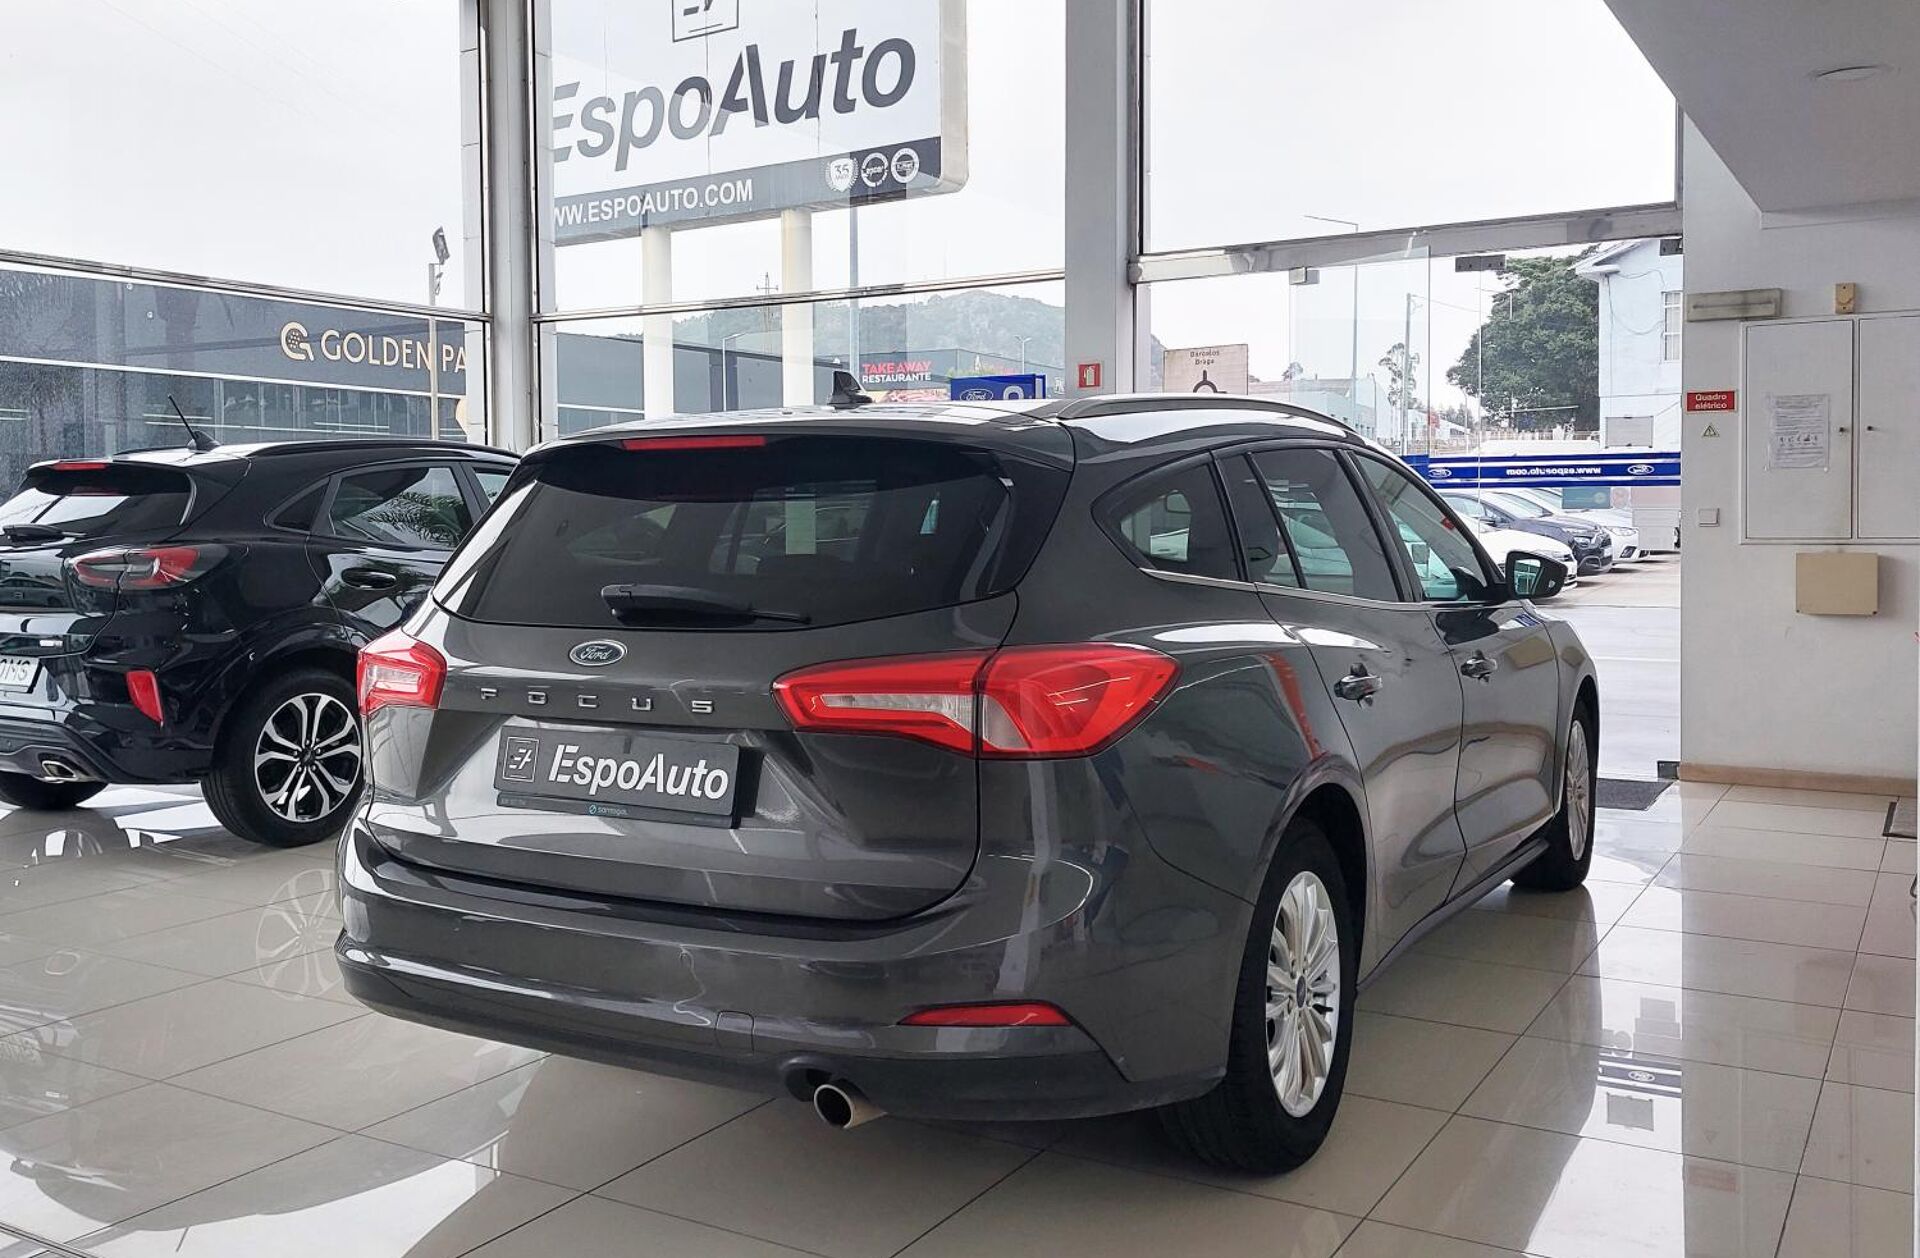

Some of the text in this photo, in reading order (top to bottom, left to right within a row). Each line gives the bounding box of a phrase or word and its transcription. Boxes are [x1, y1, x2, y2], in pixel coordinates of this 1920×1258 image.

[553, 28, 916, 172] EspoAuto
[320, 329, 431, 371] GOLDEN
[862, 371, 932, 384] RESTAURANTE
[863, 360, 932, 375] TAKE AWAY
[1695, 393, 1728, 402] Quadro
[1695, 402, 1728, 410] elétrico
[481, 687, 713, 713] FOCUS
[549, 744, 729, 800] EspoAuto
